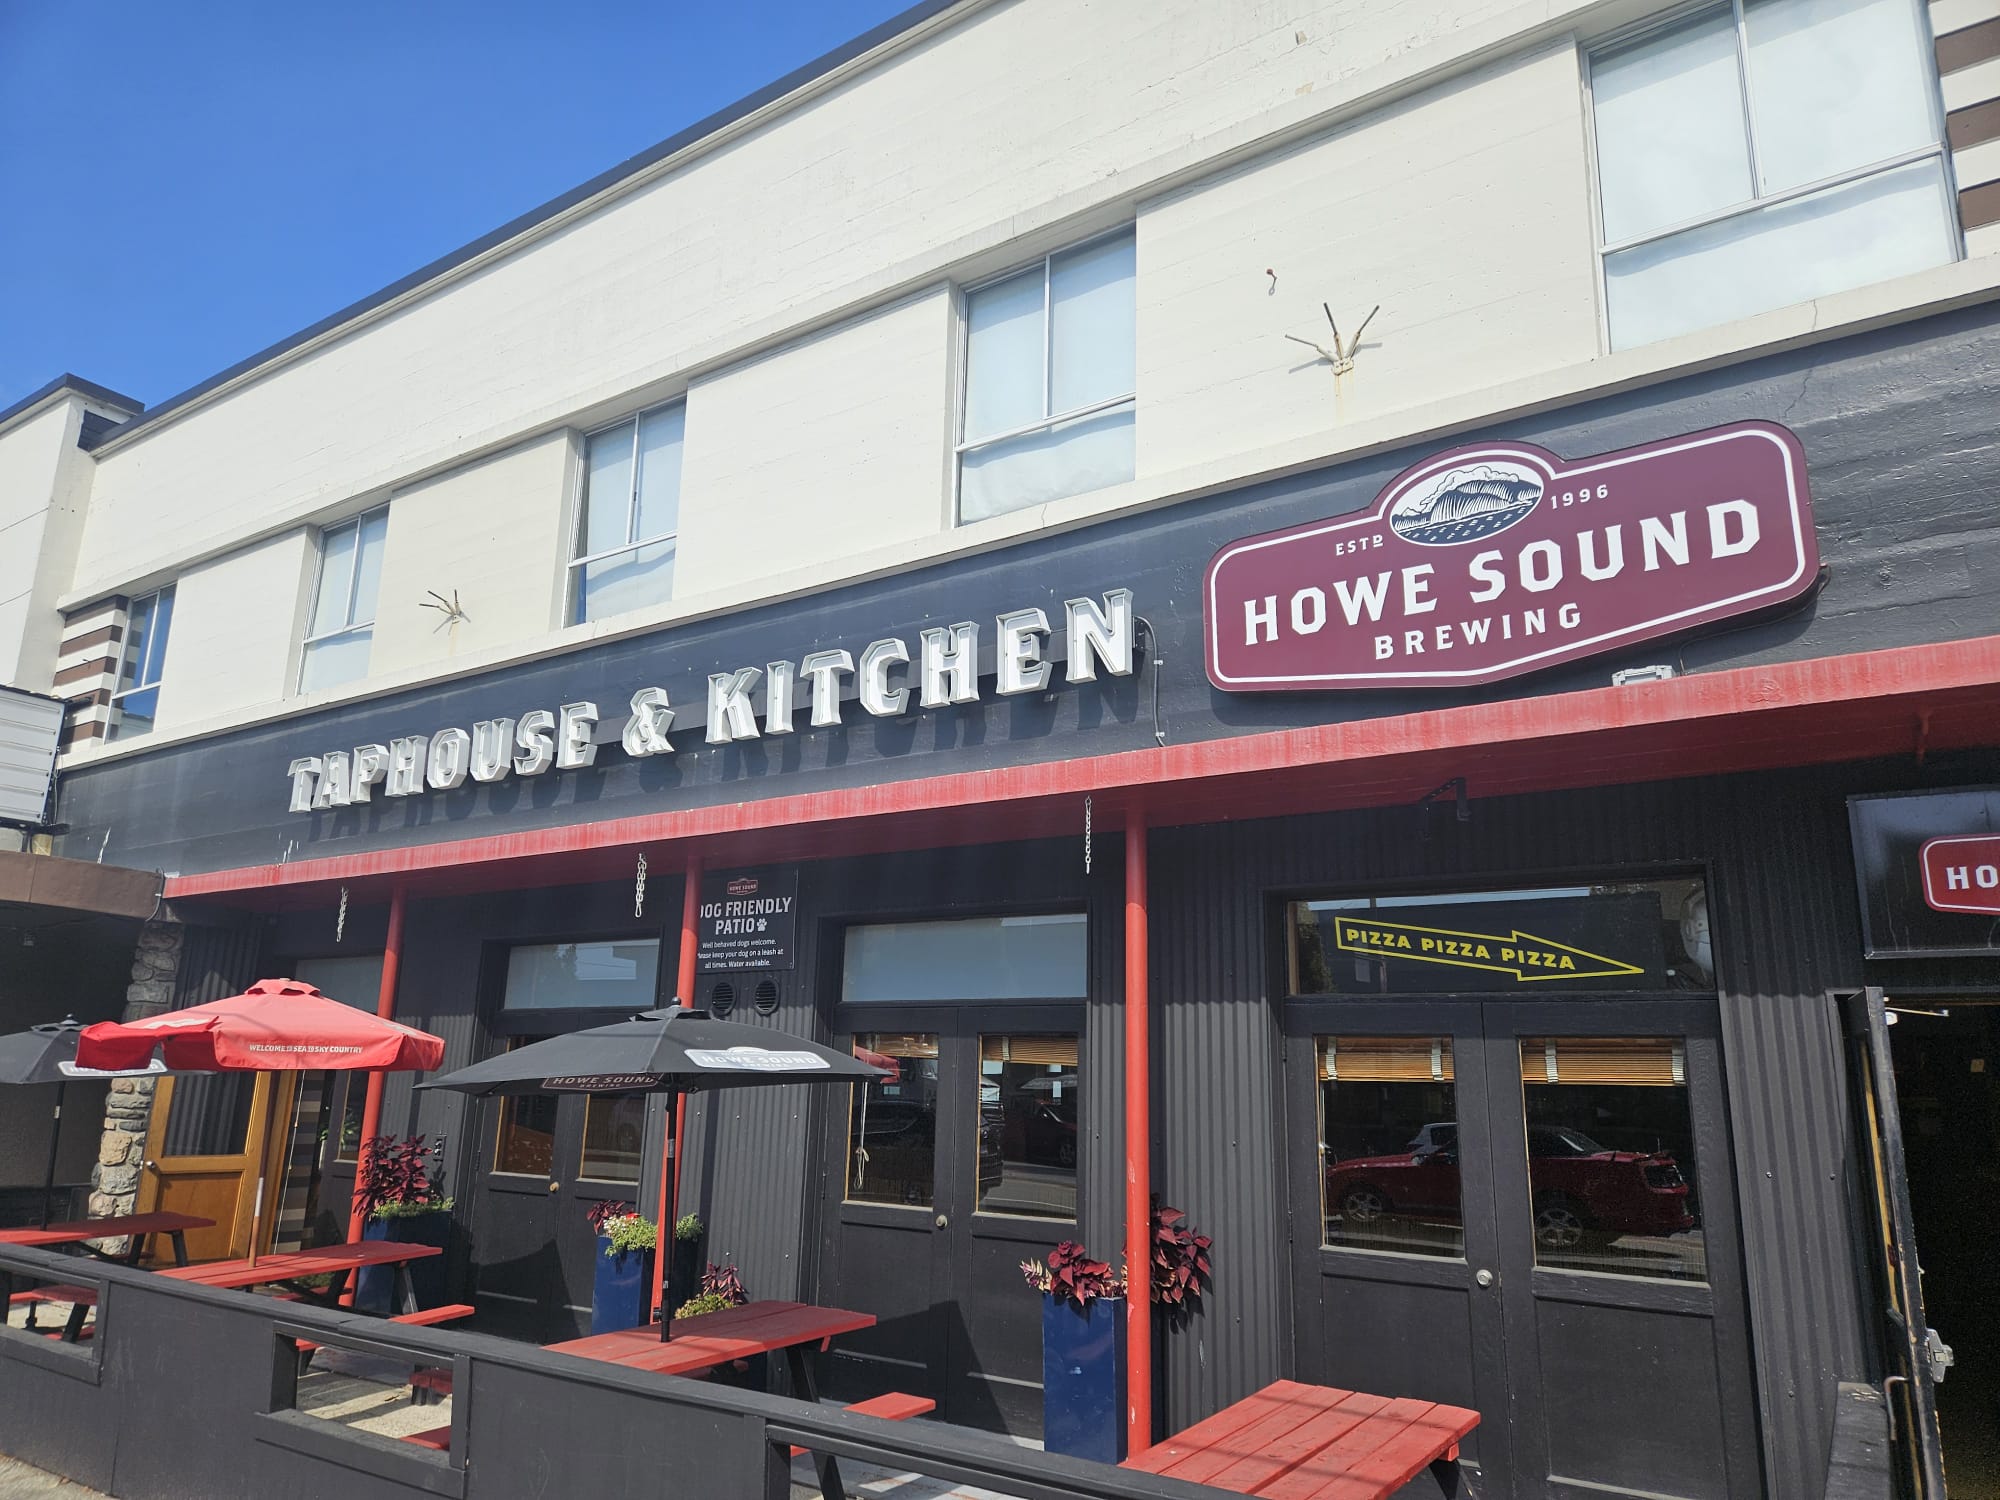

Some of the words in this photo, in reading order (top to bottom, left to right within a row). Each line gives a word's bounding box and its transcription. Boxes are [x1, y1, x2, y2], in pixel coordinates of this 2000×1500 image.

[1551, 484, 1609, 509] 1996
[1243, 563, 1438, 646] HOWE
[1469, 499, 1761, 604] SOUND
[1374, 603, 1582, 661] BREWING
[287, 701, 598, 812] TAPHOUSE
[622, 687, 675, 757] &
[705, 588, 1134, 744] KITCHEN
[725, 897, 792, 917] FRIENDLY
[715, 917, 755, 935] PATIO
[712, 951, 724, 959] keep
[725, 951, 737, 959] your
[738, 950, 748, 958] dog
[761, 948, 777, 956] leash
[713, 940, 737, 949] behaved
[737, 940, 750, 948] dogs
[1346, 928, 1411, 949] PIZZA
[1421, 938, 1490, 959] PIZZA
[1501, 948, 1575, 970] PIZZA
[728, 960, 744, 968] Water
[249, 1044, 286, 1052] WELCOME
[314, 1045, 329, 1053] SKY
[329, 1045, 363, 1054] COUNTRY
[702, 1055, 754, 1064] HOWE
[758, 1056, 818, 1064] SOUND
[553, 1076, 599, 1085] HOWE
[602, 1076, 656, 1084] SOUND
